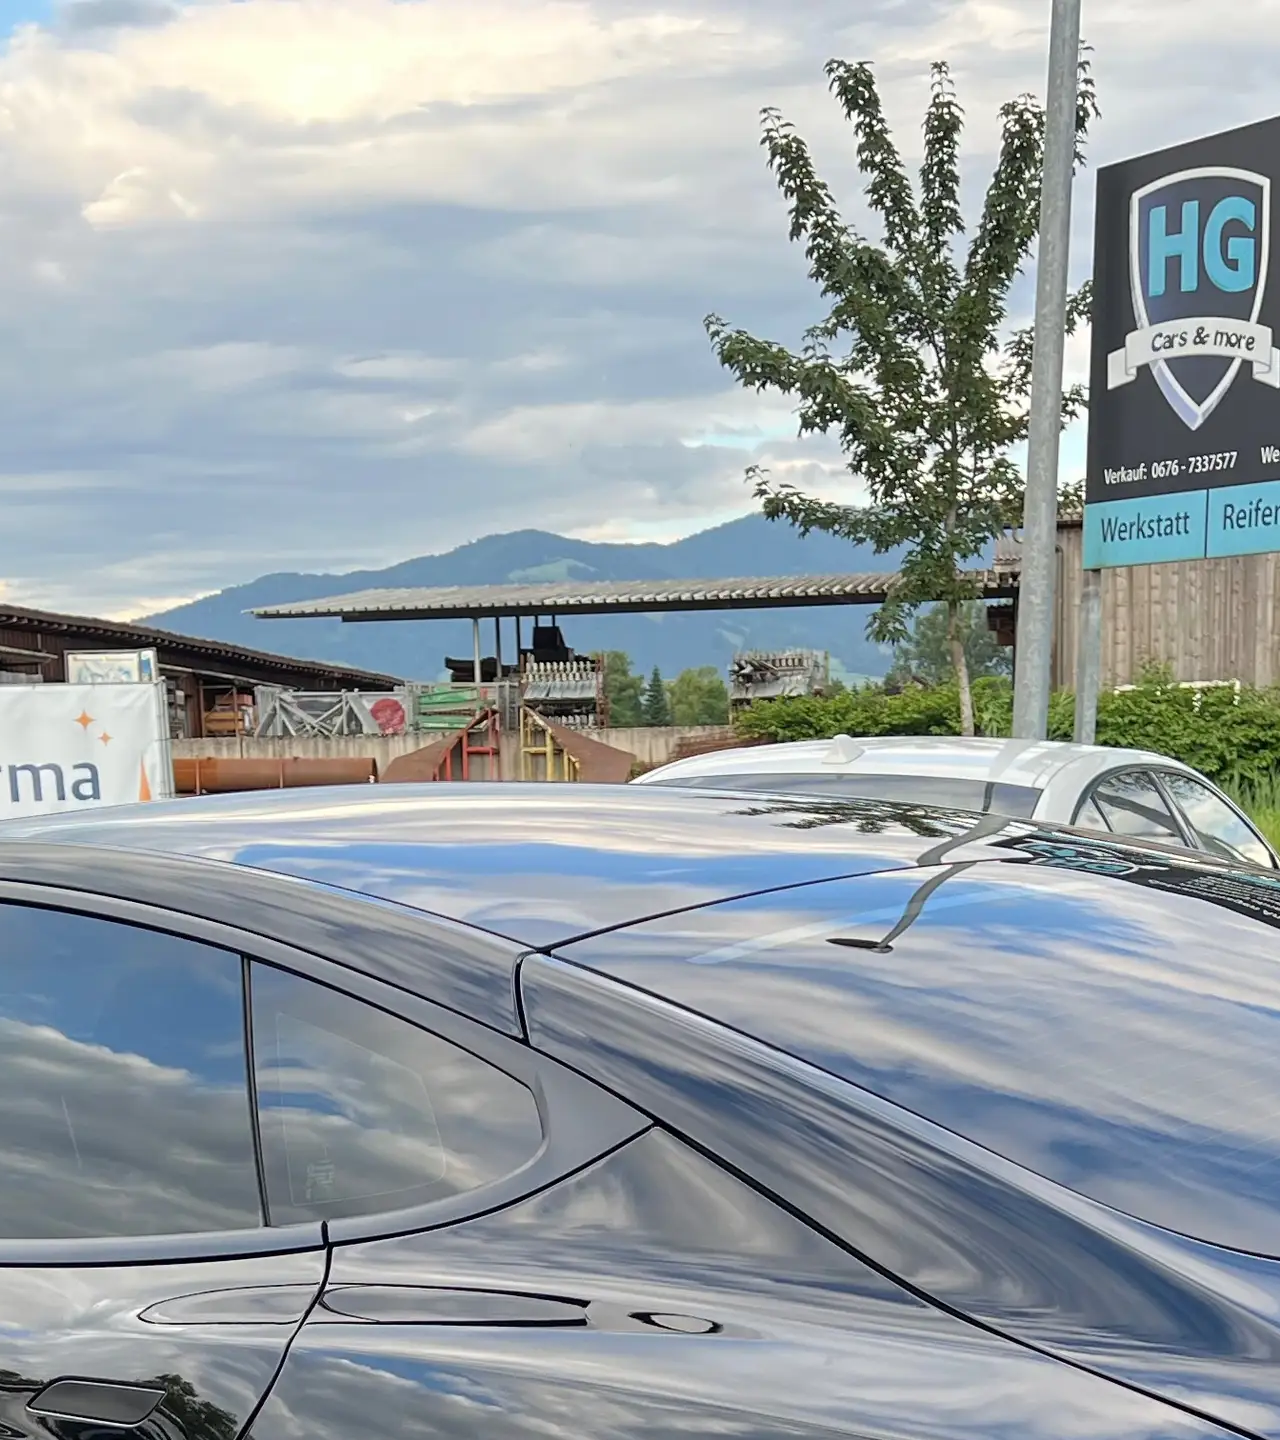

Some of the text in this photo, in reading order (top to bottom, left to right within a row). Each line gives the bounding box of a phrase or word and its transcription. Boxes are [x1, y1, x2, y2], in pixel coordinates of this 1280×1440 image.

[1149, 196, 1256, 297] HG
[1152, 326, 1255, 352] Cars & more
[1104, 463, 1148, 485] Verkauf:
[1151, 459, 1180, 479] 0676
[1188, 451, 1238, 475] 7337577
[1101, 511, 1190, 543] Werkstatt
